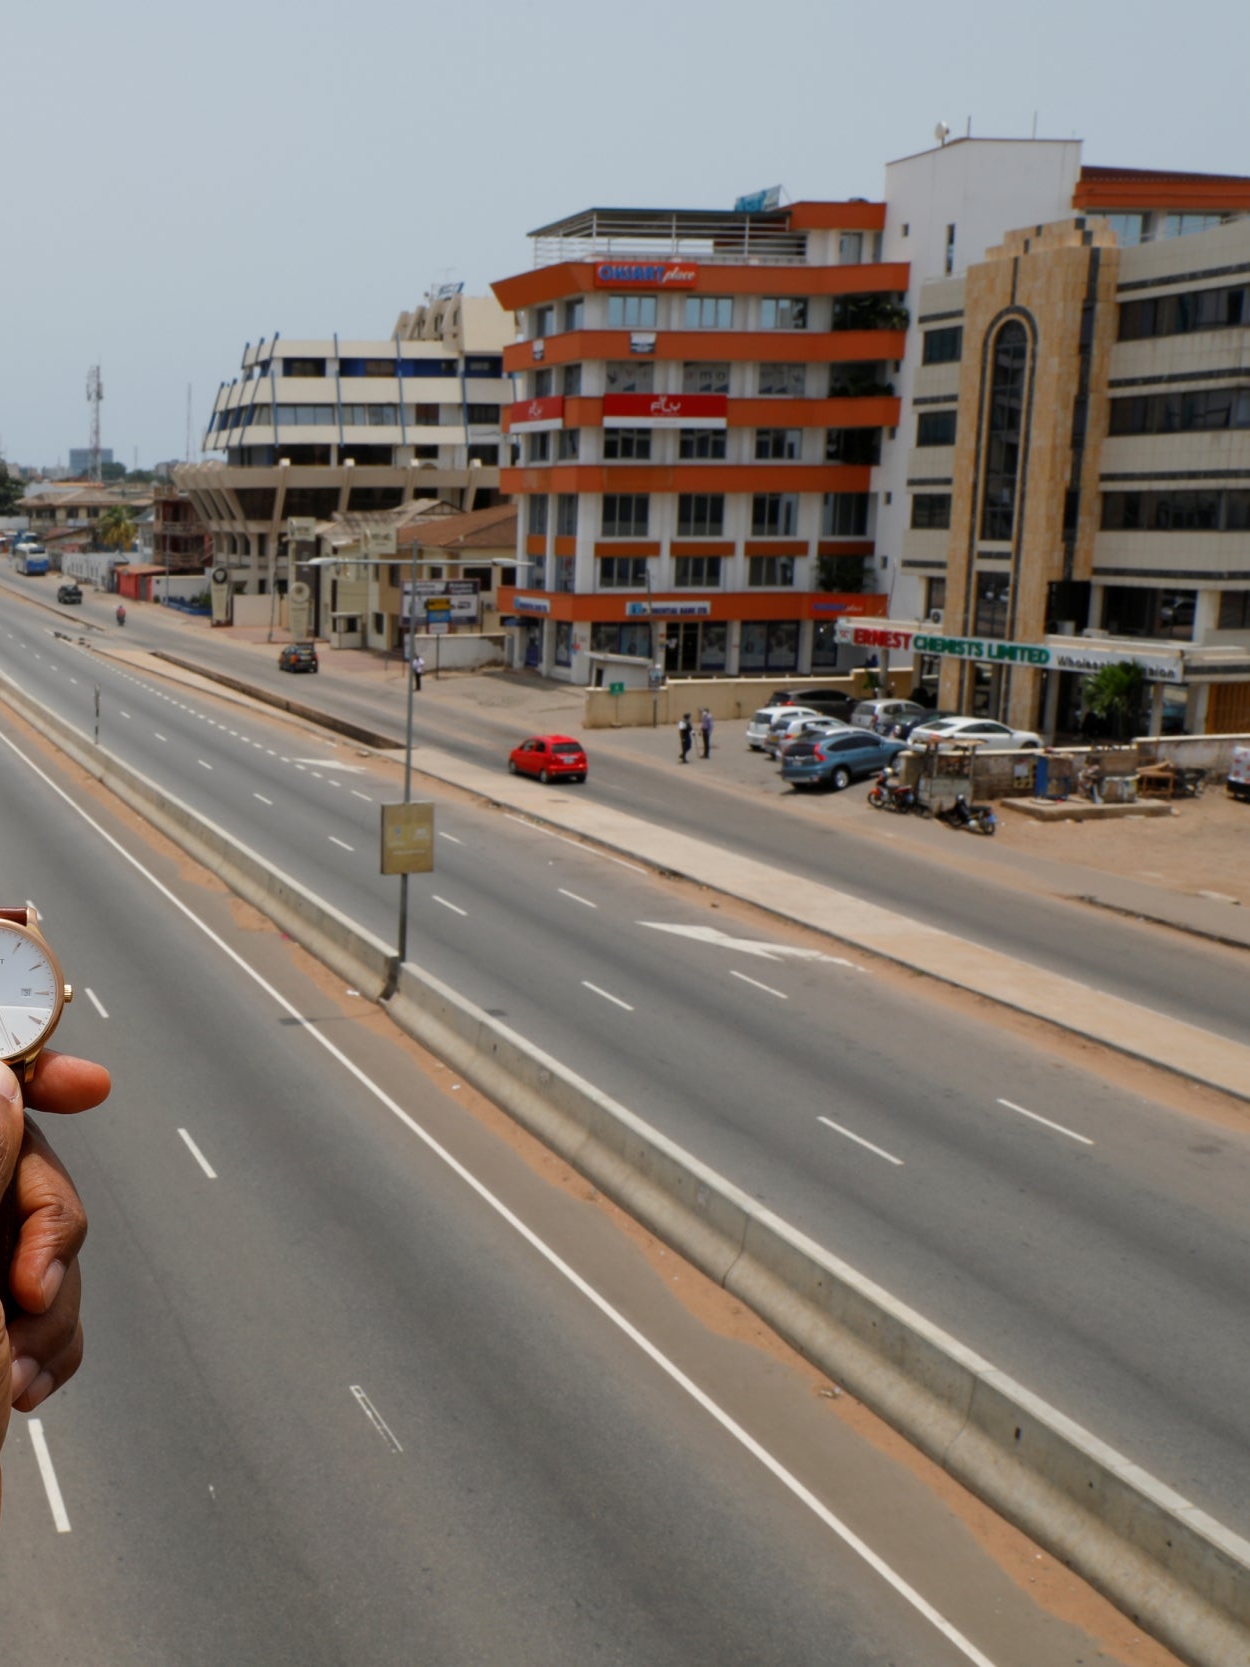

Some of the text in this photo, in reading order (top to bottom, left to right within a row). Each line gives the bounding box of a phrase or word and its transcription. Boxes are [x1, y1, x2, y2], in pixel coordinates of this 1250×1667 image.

[662, 266, 695, 284] place
[853, 628, 914, 650] ERNEST
[913, 633, 984, 657] CHEMISTS
[987, 642, 1051, 665] LIMITED
